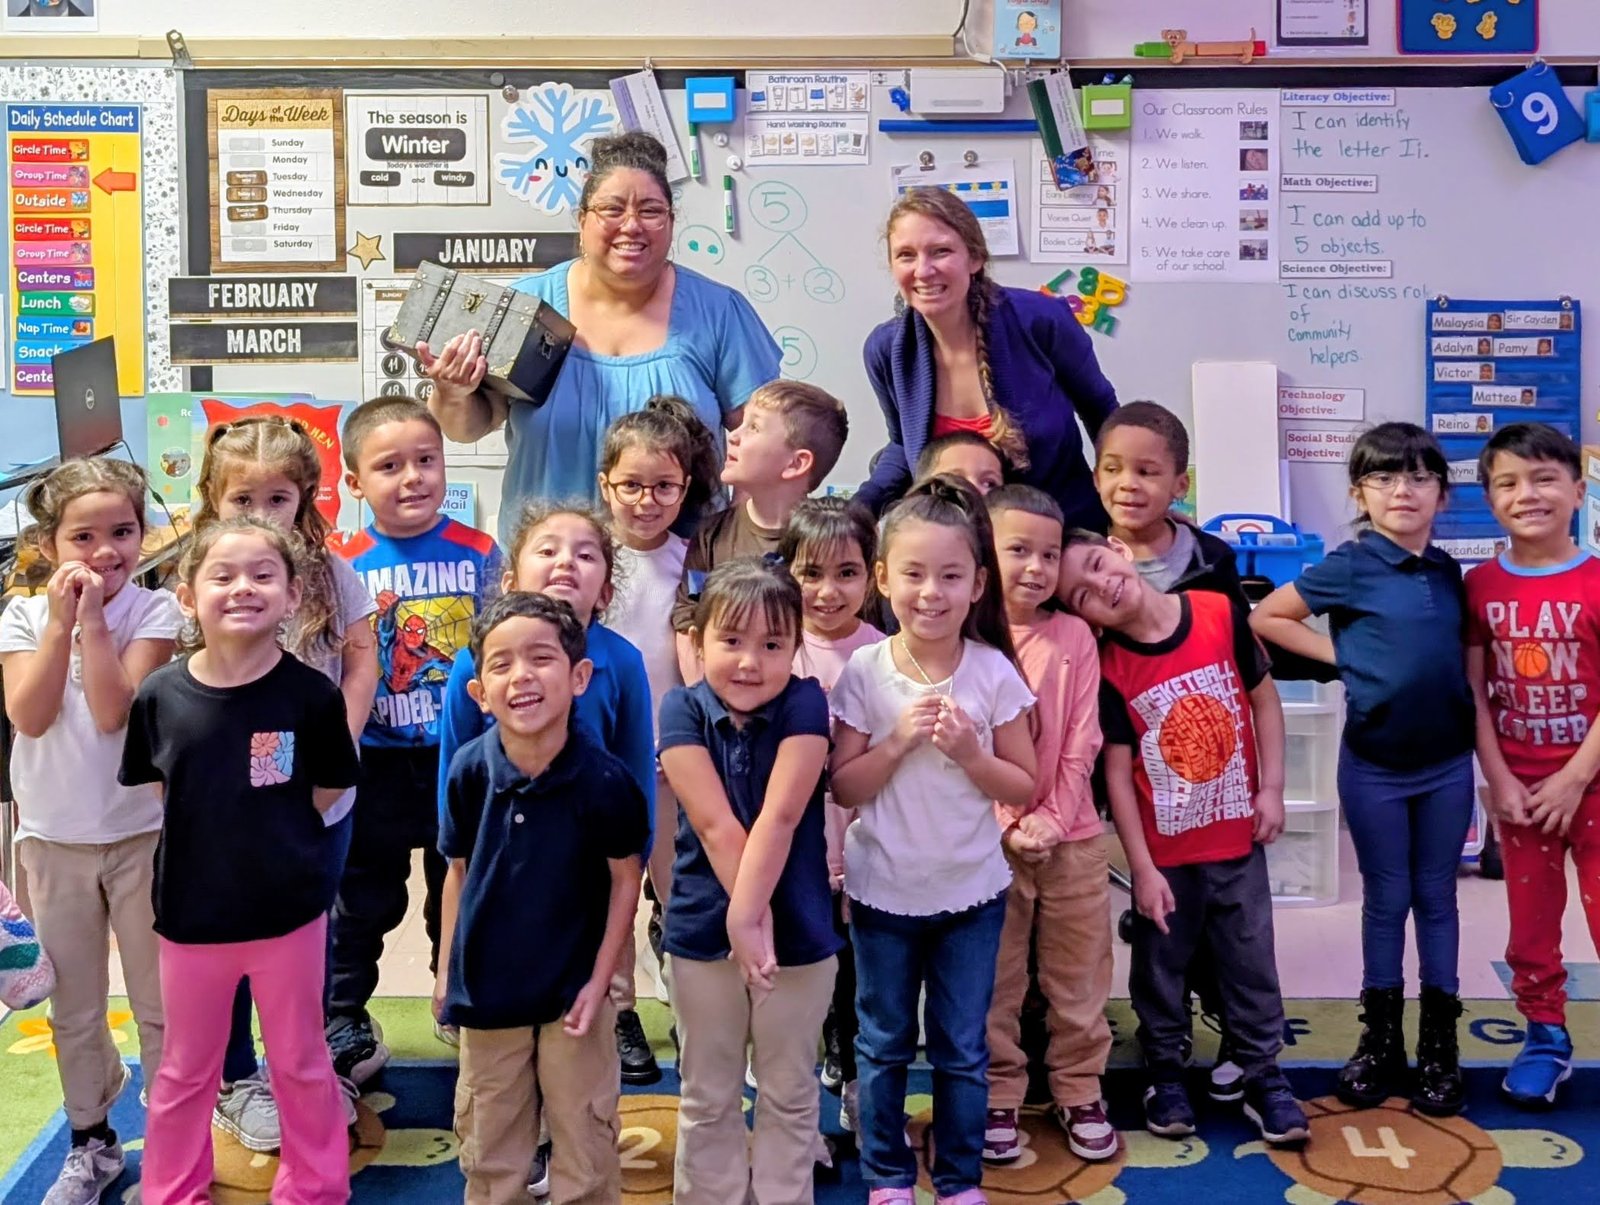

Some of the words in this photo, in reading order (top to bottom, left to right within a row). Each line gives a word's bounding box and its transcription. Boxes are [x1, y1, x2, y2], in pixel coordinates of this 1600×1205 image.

[768, 75, 813, 84] Bathroom
[815, 75, 848, 84] Routine
[1282, 92, 1329, 104] Literacy
[1333, 92, 1390, 104] Objective:
[272, 106, 282, 114] of
[284, 105, 329, 122] Week
[1143, 102, 1168, 116] Our
[1172, 102, 1233, 116] Classroom
[1237, 102, 1268, 116] Rules
[1522, 92, 1558, 134] 9
[11, 110, 40, 128] Daily
[44, 109, 97, 126] Schedule
[100, 109, 134, 127] Chart
[222, 105, 267, 127] Days
[270, 114, 284, 123] the
[367, 110, 394, 124] The
[399, 113, 452, 124] season
[456, 110, 468, 124] is
[1292, 111, 1307, 130] I
[1315, 116, 1346, 130] can
[1356, 109, 1410, 130] identify
[788, 121, 817, 130] Washing
[1156, 128, 1178, 140] We
[1181, 128, 1206, 140] walk.
[13, 144, 42, 156] Circle
[43, 144, 67, 156] Time
[271, 139, 304, 150] Sunday
[381, 134, 450, 154] Winter
[1292, 138, 1323, 158] the
[1339, 139, 1390, 158] letter
[1093, 148, 1115, 158] Time
[272, 156, 308, 166] Monday
[1142, 158, 1152, 170] 2.
[1156, 158, 1178, 169] We
[1181, 158, 1209, 170] listen.
[15, 170, 44, 182] Group
[44, 170, 68, 181] Time
[273, 173, 308, 182] Tuesday
[371, 173, 389, 182] cold
[441, 173, 467, 184] windy
[1283, 178, 1312, 186] Math
[1316, 178, 1373, 188] Objective:
[273, 190, 324, 200] Wednesday
[1142, 188, 1152, 200] 3.
[1156, 188, 1178, 199] We
[1181, 188, 1212, 200] share.
[16, 194, 67, 208] Outside
[273, 206, 314, 216] Thursday
[761, 191, 790, 224] 5
[1287, 205, 1306, 226] I
[1313, 212, 1344, 228] can
[1352, 209, 1381, 228] add
[1388, 216, 1404, 230] up
[1406, 208, 1426, 228] to
[15, 223, 42, 234] Circle
[44, 224, 69, 234] Time
[273, 222, 300, 233] Friday
[1142, 218, 1152, 228] 4.
[1156, 218, 1178, 228] We
[1181, 217, 1208, 228] clean
[1212, 220, 1228, 232] up.
[273, 240, 313, 250] Saturday
[438, 238, 538, 264] JANUARY
[1294, 236, 1308, 254] 5
[1321, 238, 1384, 258] objects.
[16, 248, 46, 260] Group
[47, 248, 69, 258] Time
[1142, 247, 1152, 258] 5.
[1156, 247, 1178, 258] We
[1181, 247, 1204, 258] take
[1206, 250, 1230, 258] care
[1156, 260, 1170, 270] of
[1172, 262, 1190, 270] our
[1193, 260, 1227, 271] school.
[1282, 264, 1326, 273] Science
[1330, 264, 1386, 276] Objective:
[18, 272, 71, 284] Centers
[752, 269, 772, 295] 3
[813, 270, 835, 299] 2
[208, 282, 318, 308] FEBRUARY
[1282, 284, 1297, 298] I
[1302, 287, 1330, 298] can
[1338, 284, 1396, 299] discuss
[21, 296, 61, 309] Lunch
[1290, 304, 1310, 323] of
[1434, 318, 1484, 331] Malaysia
[1506, 314, 1522, 324] Sir
[1524, 314, 1558, 326] Cayden
[18, 322, 40, 336] Nap
[42, 322, 69, 334] Time
[226, 328, 302, 354] MARCH
[18, 344, 63, 358] Snack
[782, 336, 802, 366] 5
[1434, 342, 1474, 356] Adalyn
[1498, 343, 1528, 354] Pamy
[388, 358, 398, 372] 11
[16, 370, 54, 383] Cente
[1436, 368, 1474, 378] Victor
[1280, 390, 1345, 402] Technology
[1474, 392, 1517, 403] Matteo
[1280, 405, 1336, 416] Objective:
[1438, 418, 1470, 430] Reino
[1288, 434, 1322, 443] Social
[1326, 434, 1358, 443] Studi
[1288, 448, 1344, 458] Objective:
[1486, 600, 1582, 639] PLAY
[1129, 660, 1235, 714] BASKETBALL
[1282, 1018, 1312, 1046] F
[1469, 1018, 1526, 1044] G
[618, 1127, 662, 1170] 2
[1341, 1126, 1417, 1169] 4
